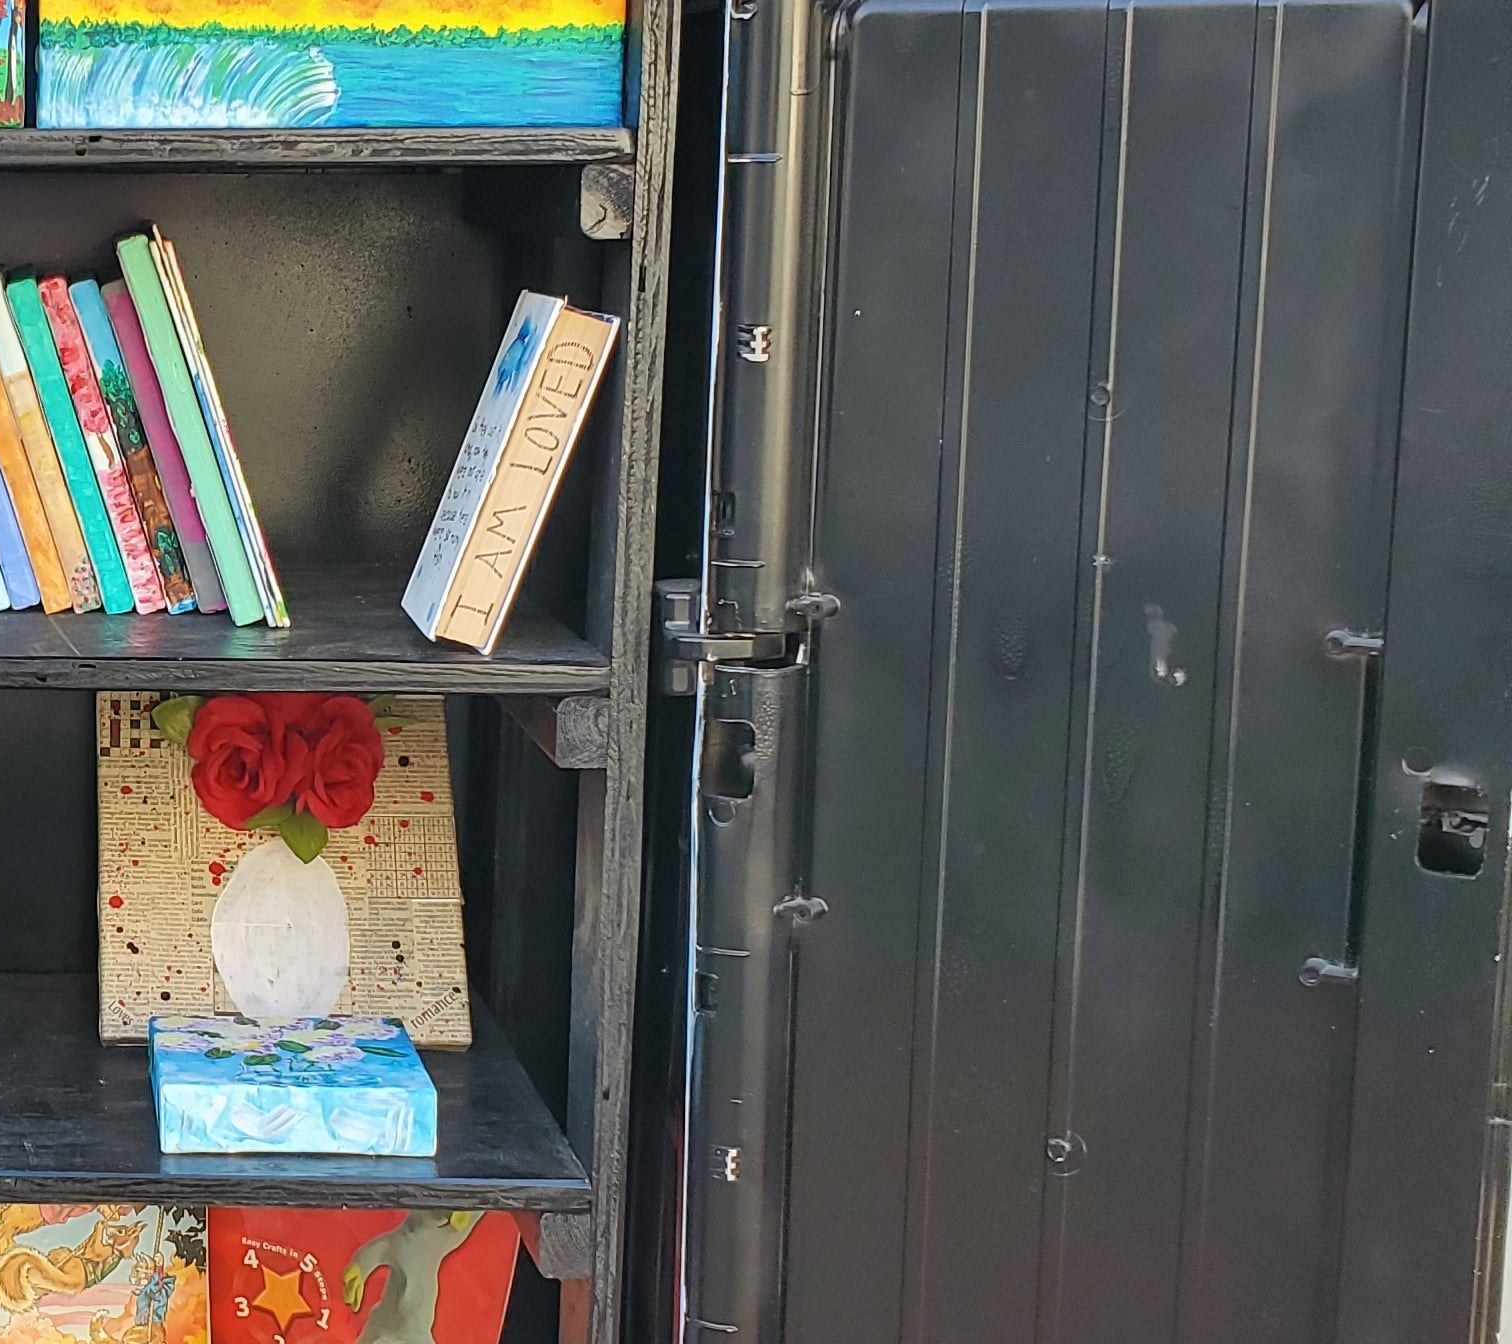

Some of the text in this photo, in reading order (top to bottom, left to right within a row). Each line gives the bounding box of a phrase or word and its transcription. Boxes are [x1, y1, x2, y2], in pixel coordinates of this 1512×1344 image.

[450, 594, 494, 626] I
[474, 505, 527, 580] AM
[510, 341, 594, 476] LOVED
[409, 990, 458, 1032] romance
[242, 1237, 261, 1249] Easy
[262, 1241, 287, 1256] Crafts
[299, 1253, 318, 1273] 5
[243, 1249, 259, 1269] 4
[234, 1297, 250, 1317] 3
[316, 1307, 331, 1330] 1
